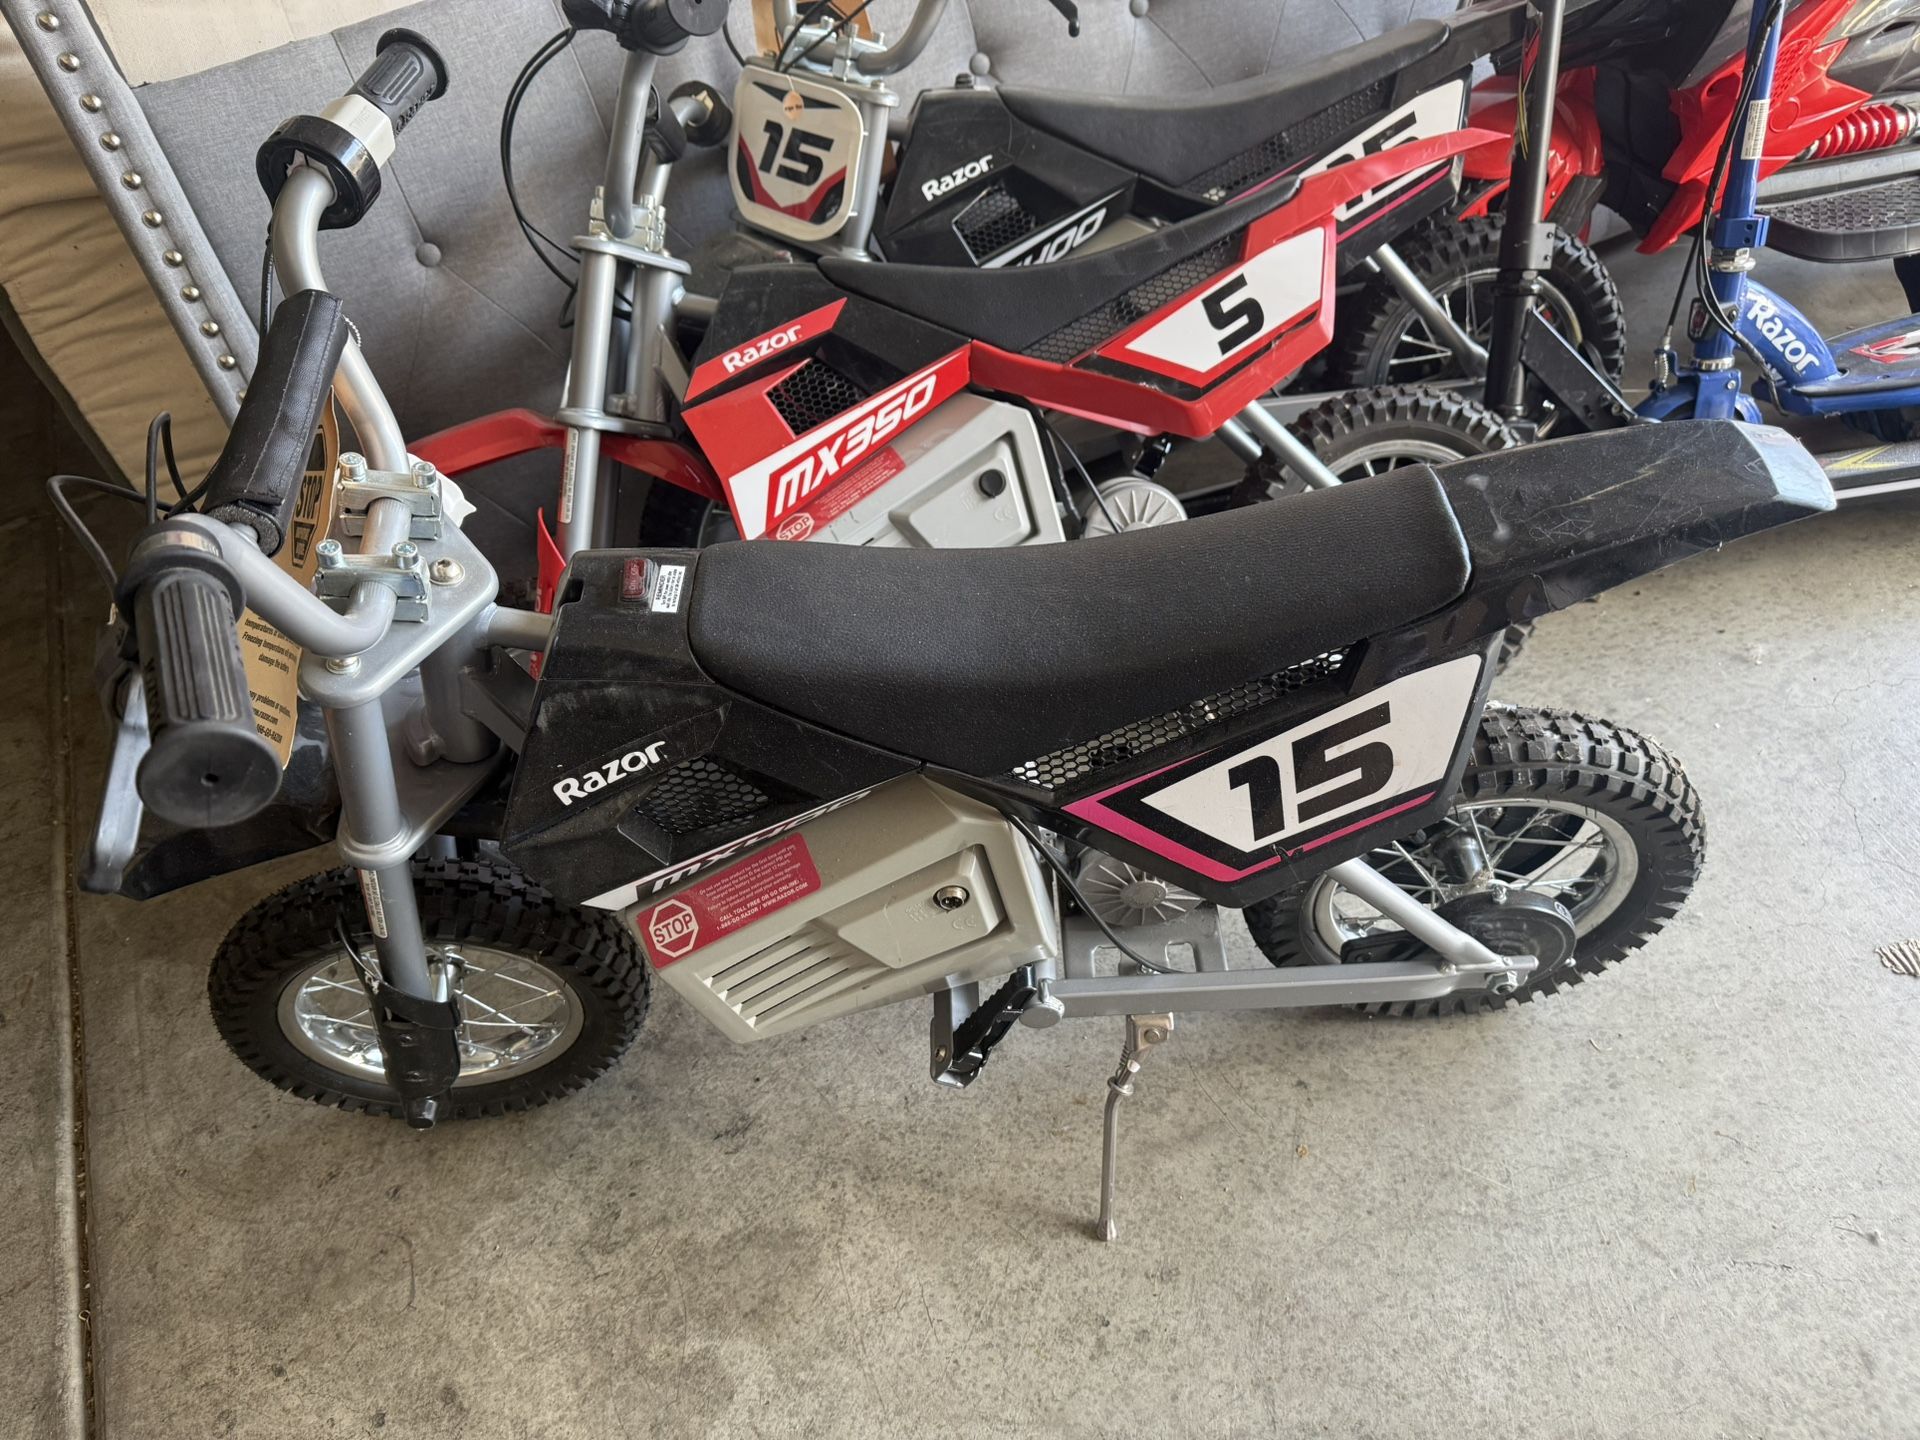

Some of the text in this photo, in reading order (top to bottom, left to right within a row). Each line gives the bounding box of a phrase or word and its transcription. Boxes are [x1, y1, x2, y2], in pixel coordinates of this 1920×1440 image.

[758, 119, 834, 187] 15
[921, 154, 994, 202] Razor
[1201, 272, 1265, 356] 5
[1746, 288, 1820, 373] Razor
[722, 324, 804, 374] Razor
[774, 373, 937, 518] MX350
[295, 475, 322, 519] STOP
[779, 516, 811, 541] STOP
[553, 740, 667, 806] Razor
[1227, 702, 1392, 843] 15
[654, 913, 693, 944] STOP
[718, 911, 732, 921] CALL
[732, 904, 746, 914] TOLL
[746, 897, 761, 908] FREE
[768, 889, 778, 897] GO
